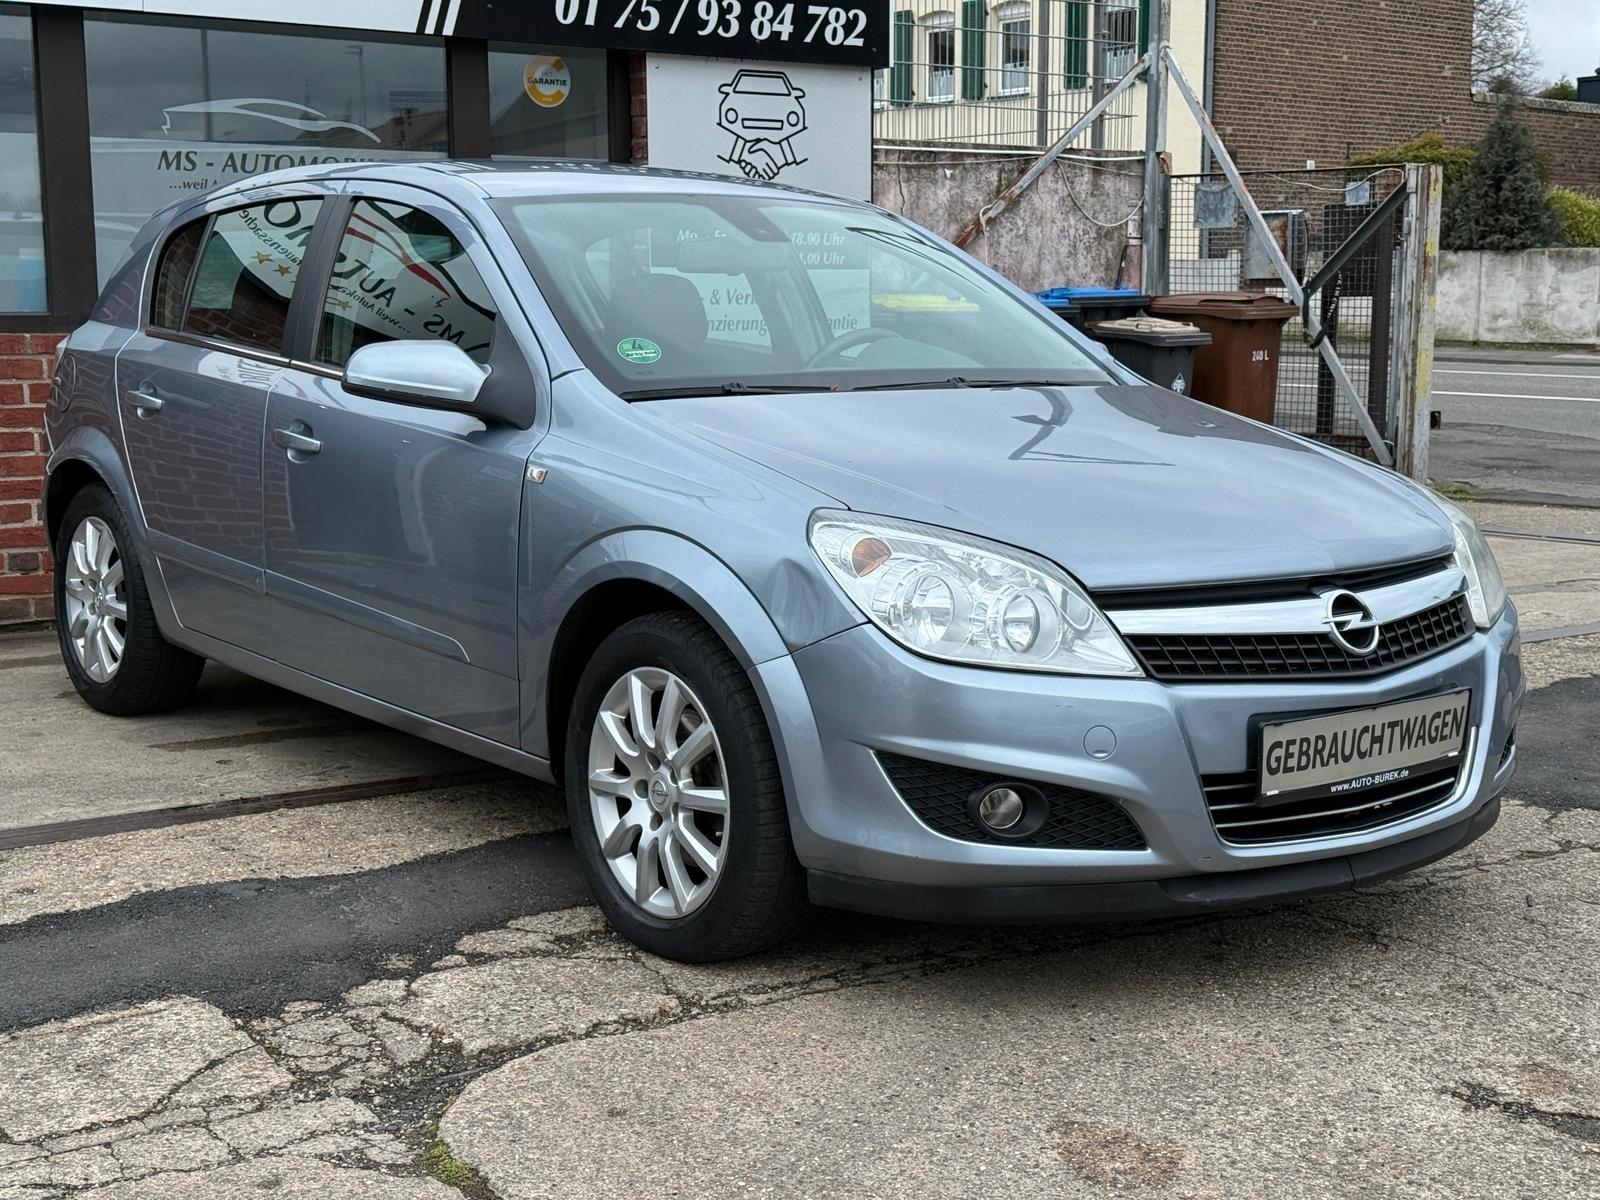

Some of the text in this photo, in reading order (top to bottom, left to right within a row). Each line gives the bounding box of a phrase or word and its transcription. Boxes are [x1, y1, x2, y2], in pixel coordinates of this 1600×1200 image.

[555, 0, 598, 26] 01
[614, 0, 660, 31] 75
[698, 0, 742, 37] 93
[750, 1, 794, 41] 84
[803, 5, 867, 46] 782
[527, 76, 568, 87] GARANTIE
[157, 150, 197, 171] MS
[823, 231, 846, 246] Uhr
[823, 251, 846, 265] Uhr
[710, 288, 720, 305] &
[1266, 705, 1466, 776] GEBRAUCHTWAGEN
[1330, 769, 1410, 793] www.AUTO-BUREK.de
